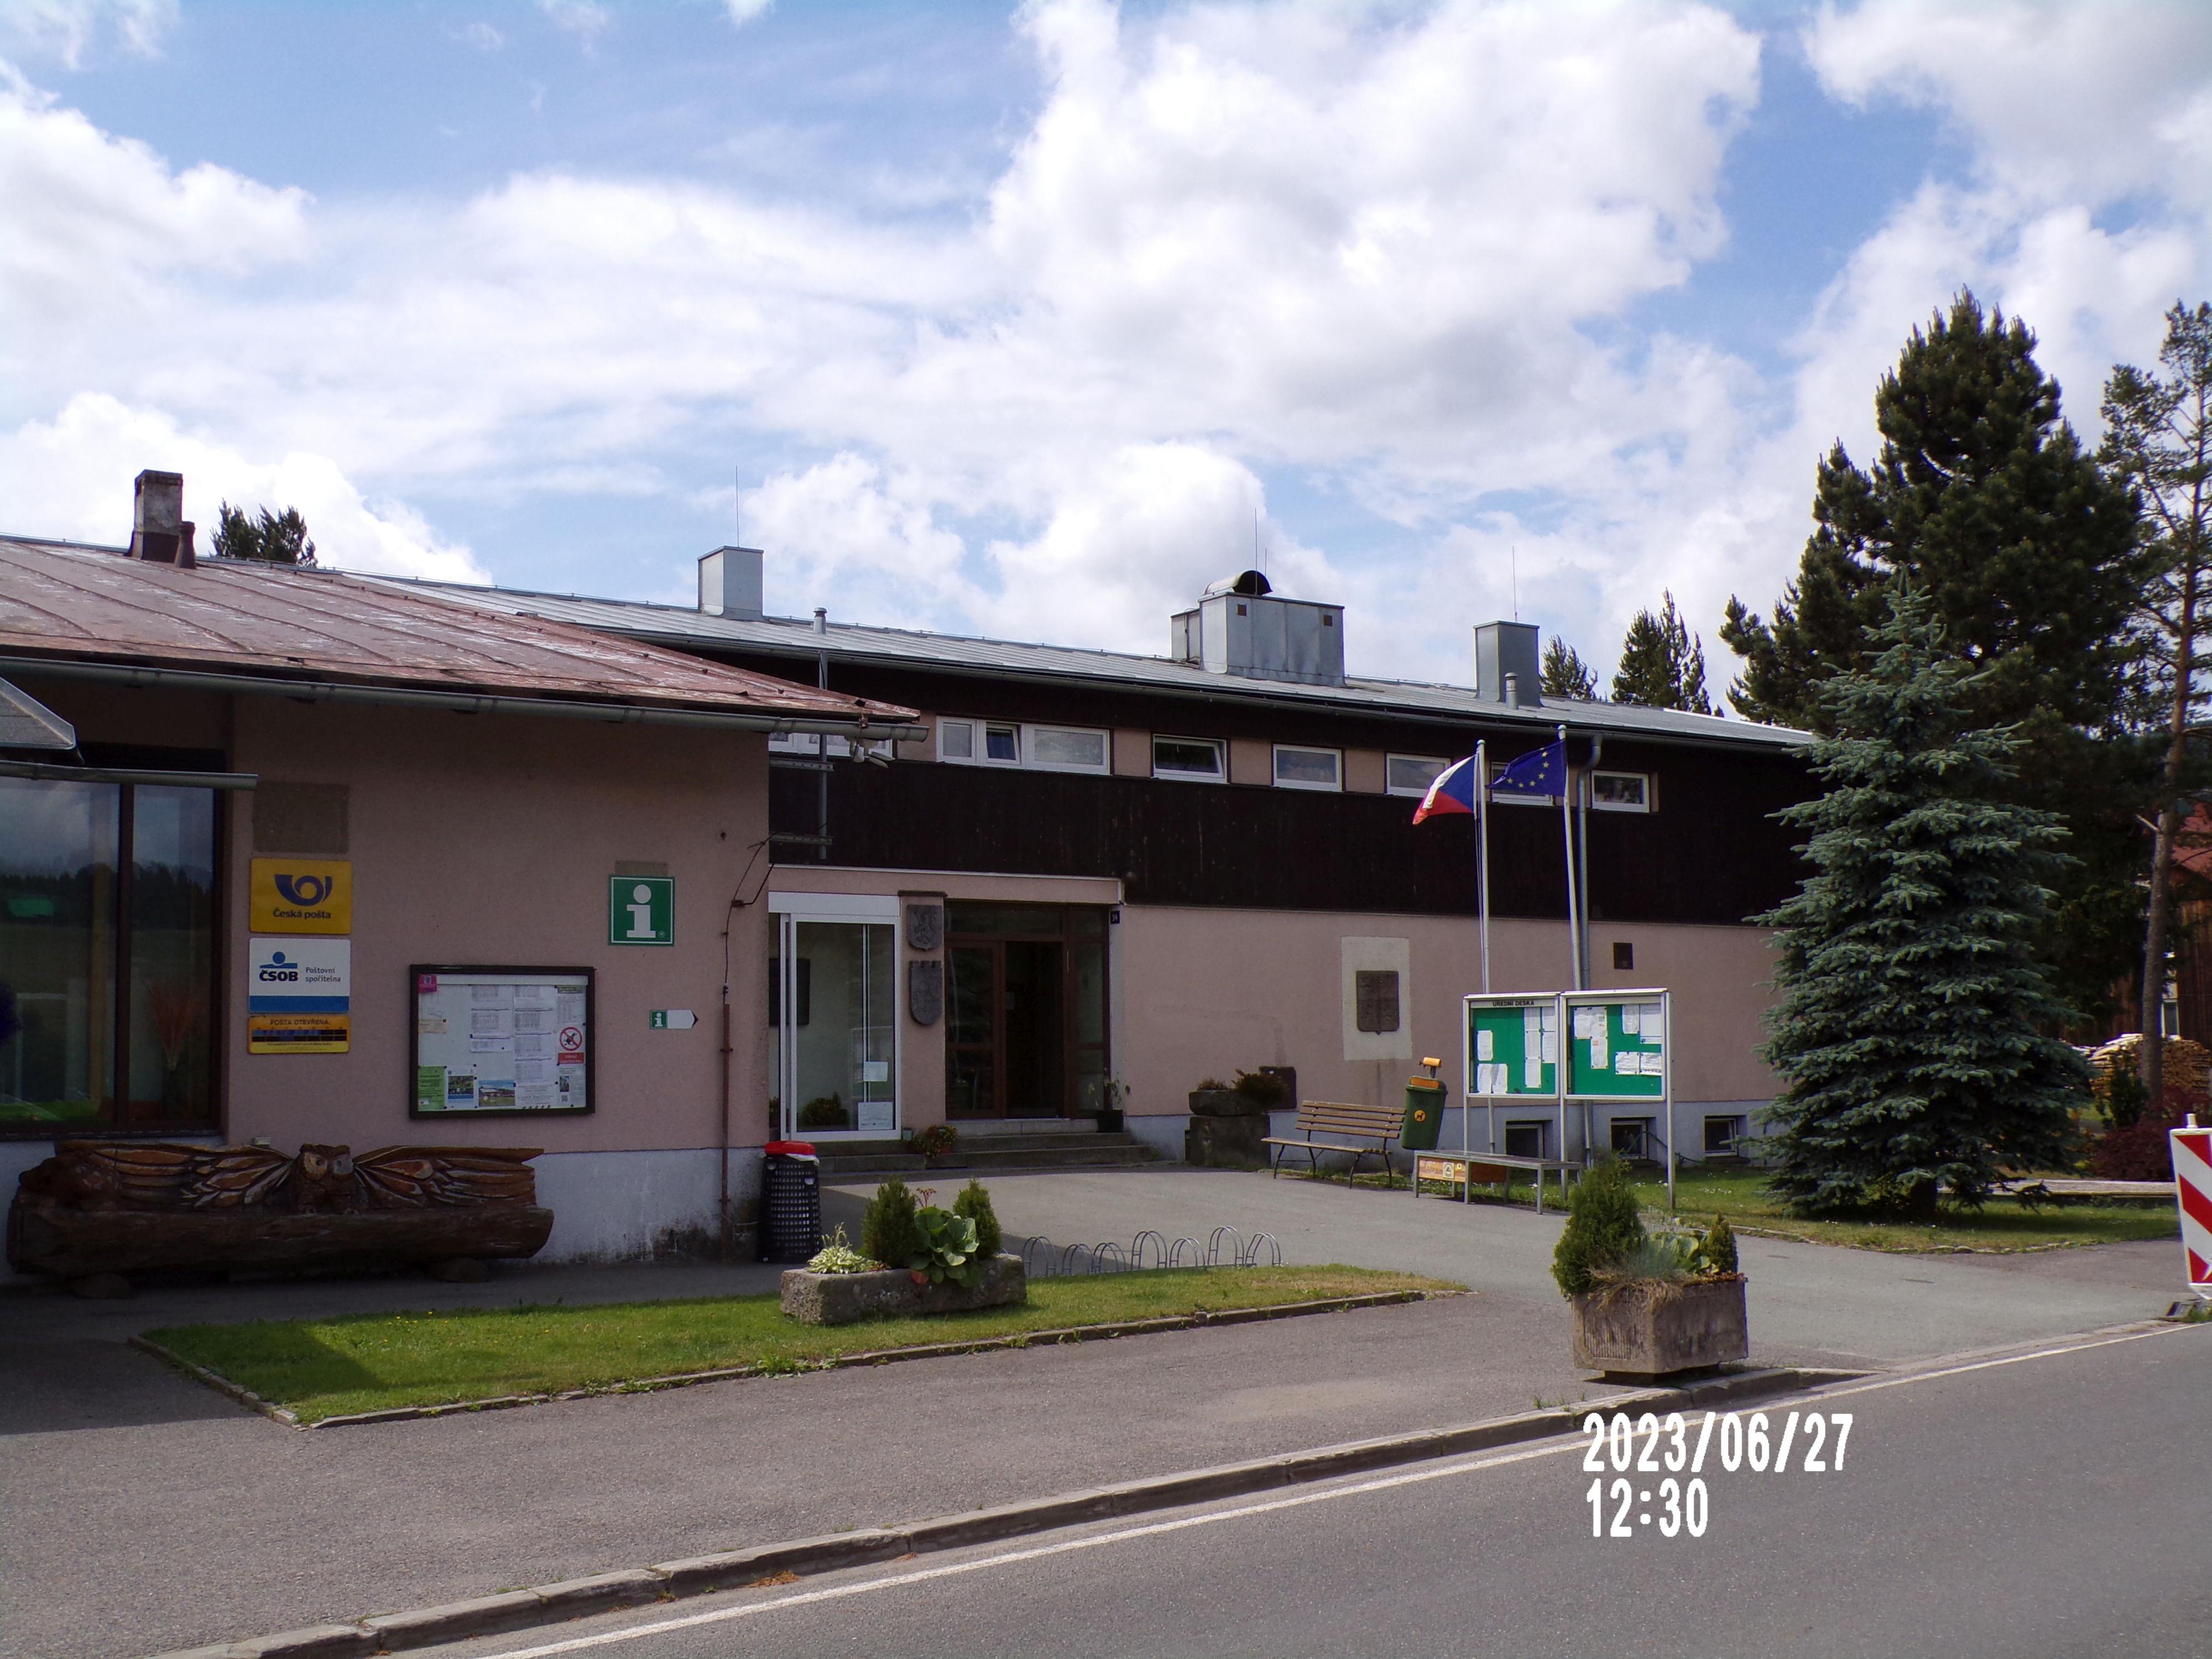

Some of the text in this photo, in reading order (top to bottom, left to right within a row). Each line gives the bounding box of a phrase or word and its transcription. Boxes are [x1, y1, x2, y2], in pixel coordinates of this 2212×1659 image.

[273, 908, 331, 920] Česká pošta
[259, 969, 298, 982] ČSOB
[306, 975, 341, 983] spořitelna
